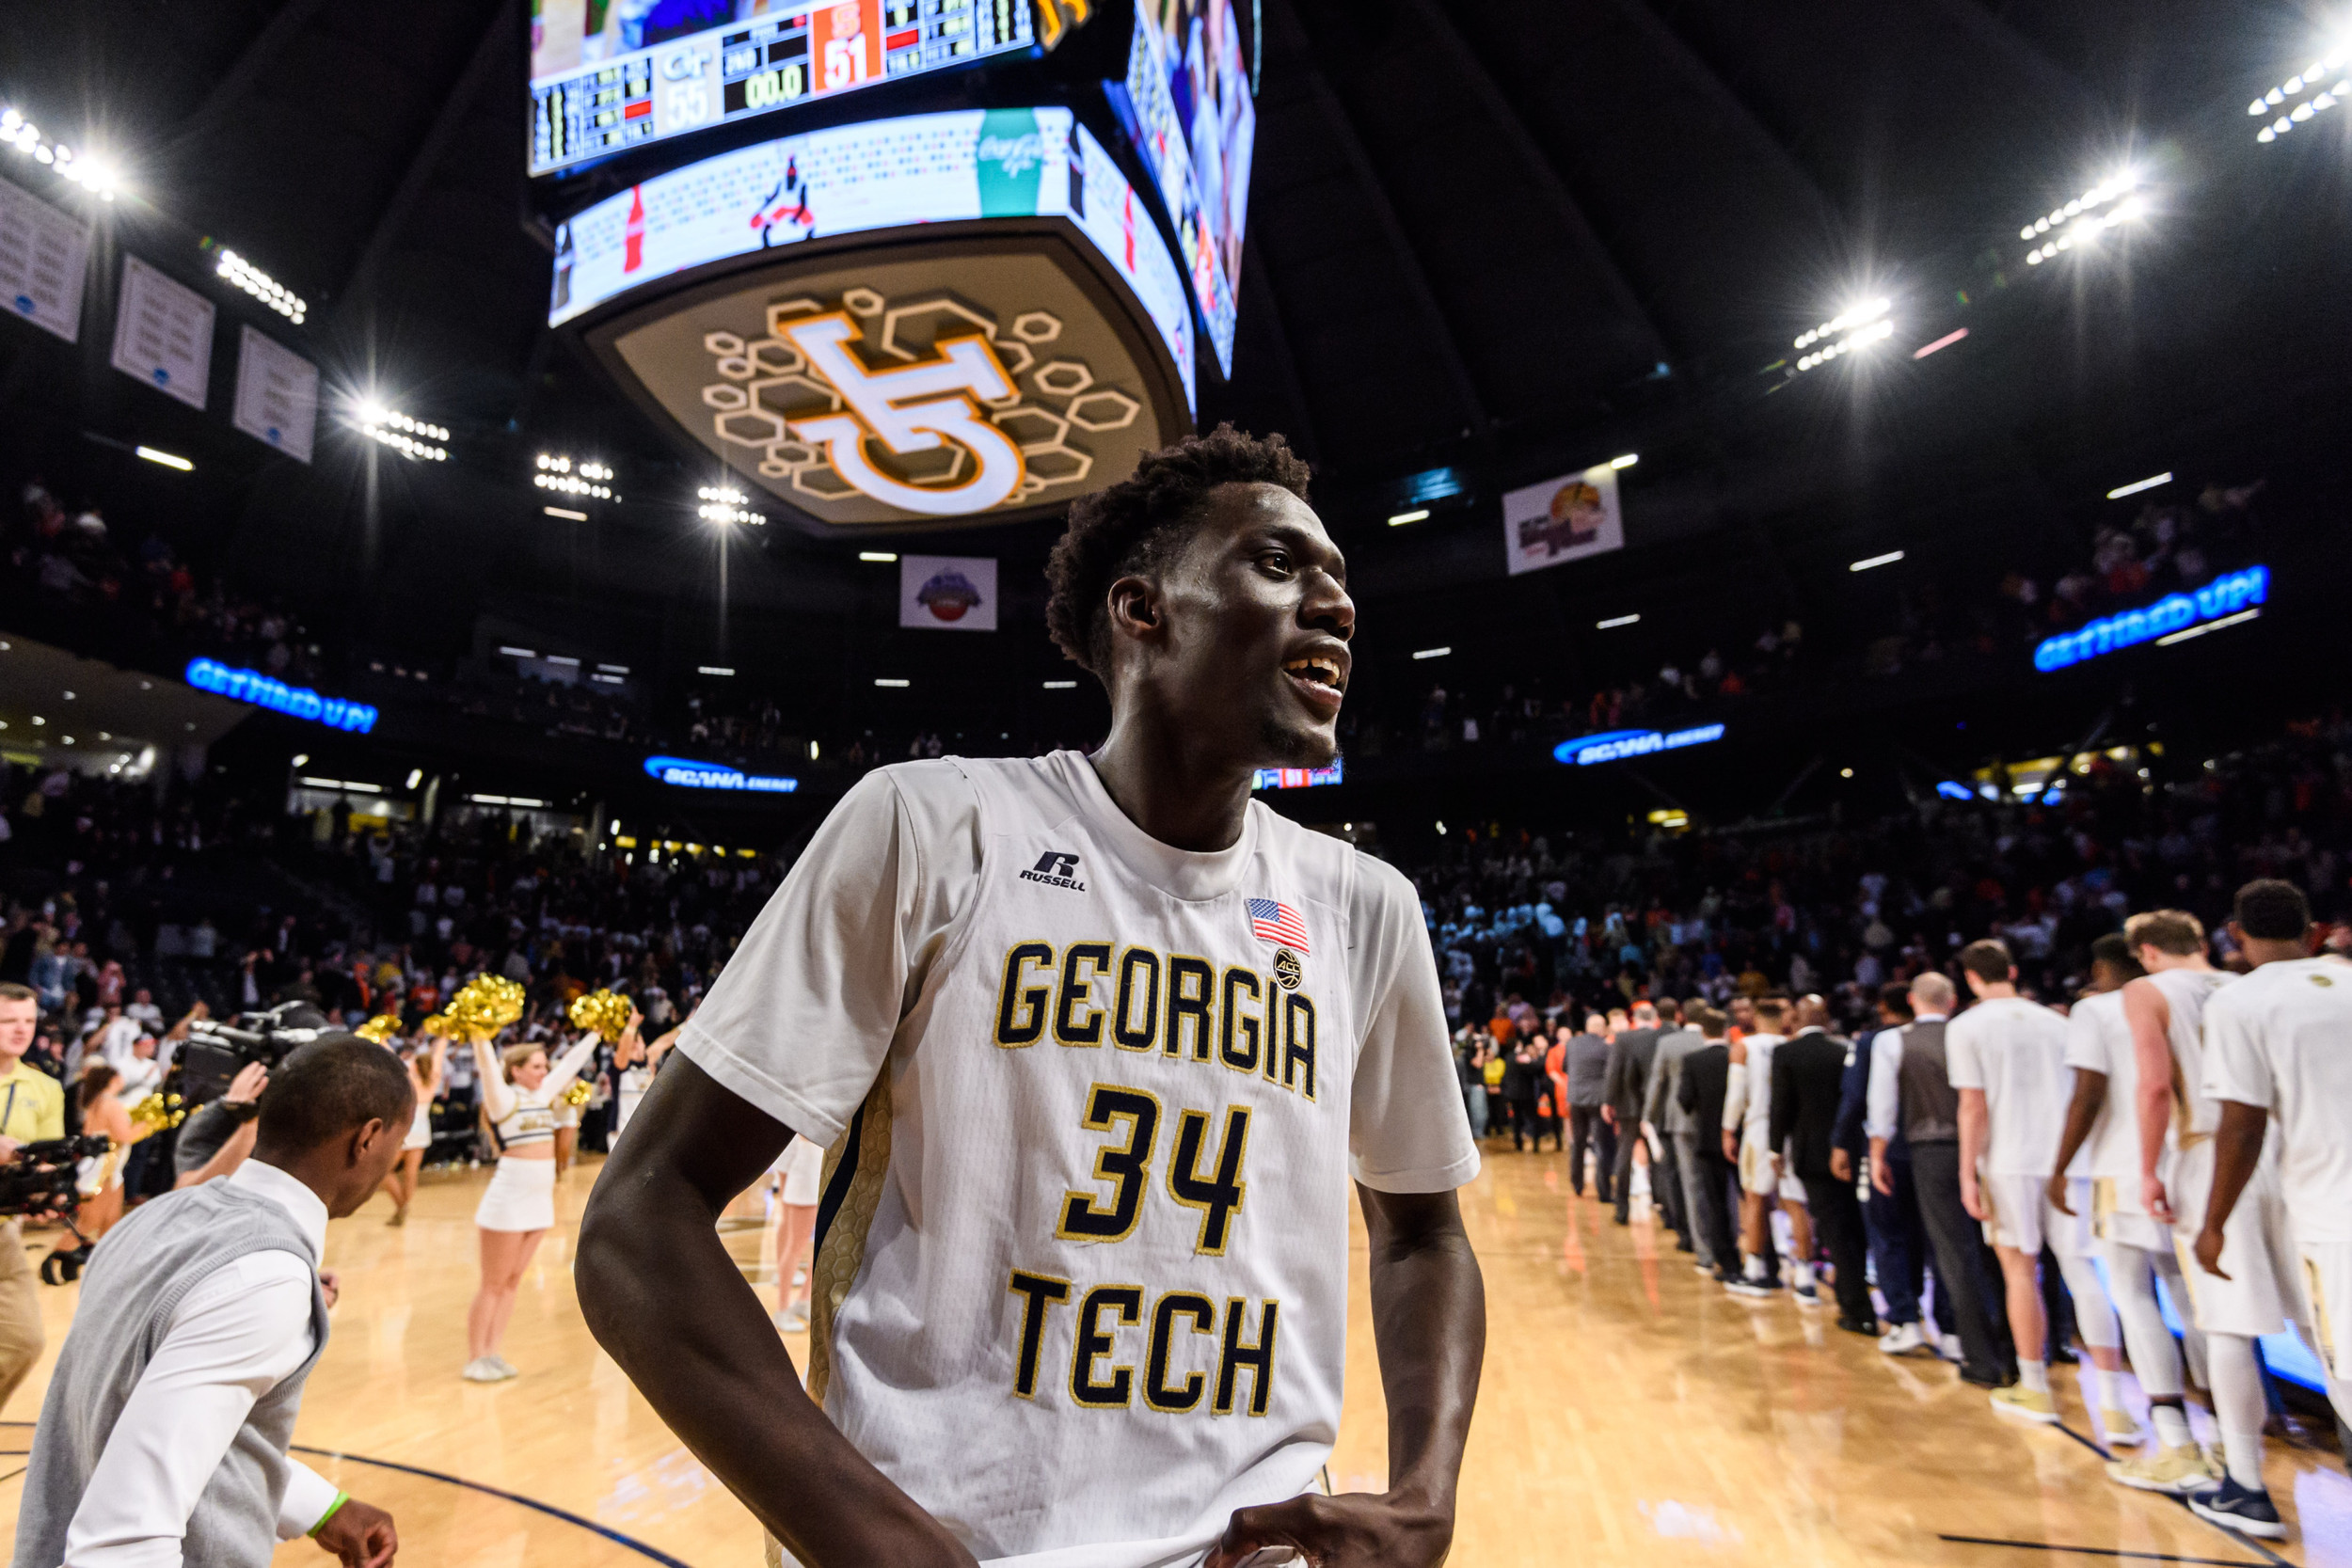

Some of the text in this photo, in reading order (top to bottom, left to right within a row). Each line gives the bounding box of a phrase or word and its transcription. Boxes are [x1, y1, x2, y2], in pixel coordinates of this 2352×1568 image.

[745, 65, 803, 109] 00.0
[824, 32, 867, 89] 51
[665, 79, 709, 133] 55
[1019, 869, 1086, 893] RUSSELL
[1277, 959, 1300, 974] ACC
[993, 940, 1317, 1102] GEORGIA
[1055, 1082, 1253, 1257] 34
[1009, 1267, 1280, 1417] TECH
